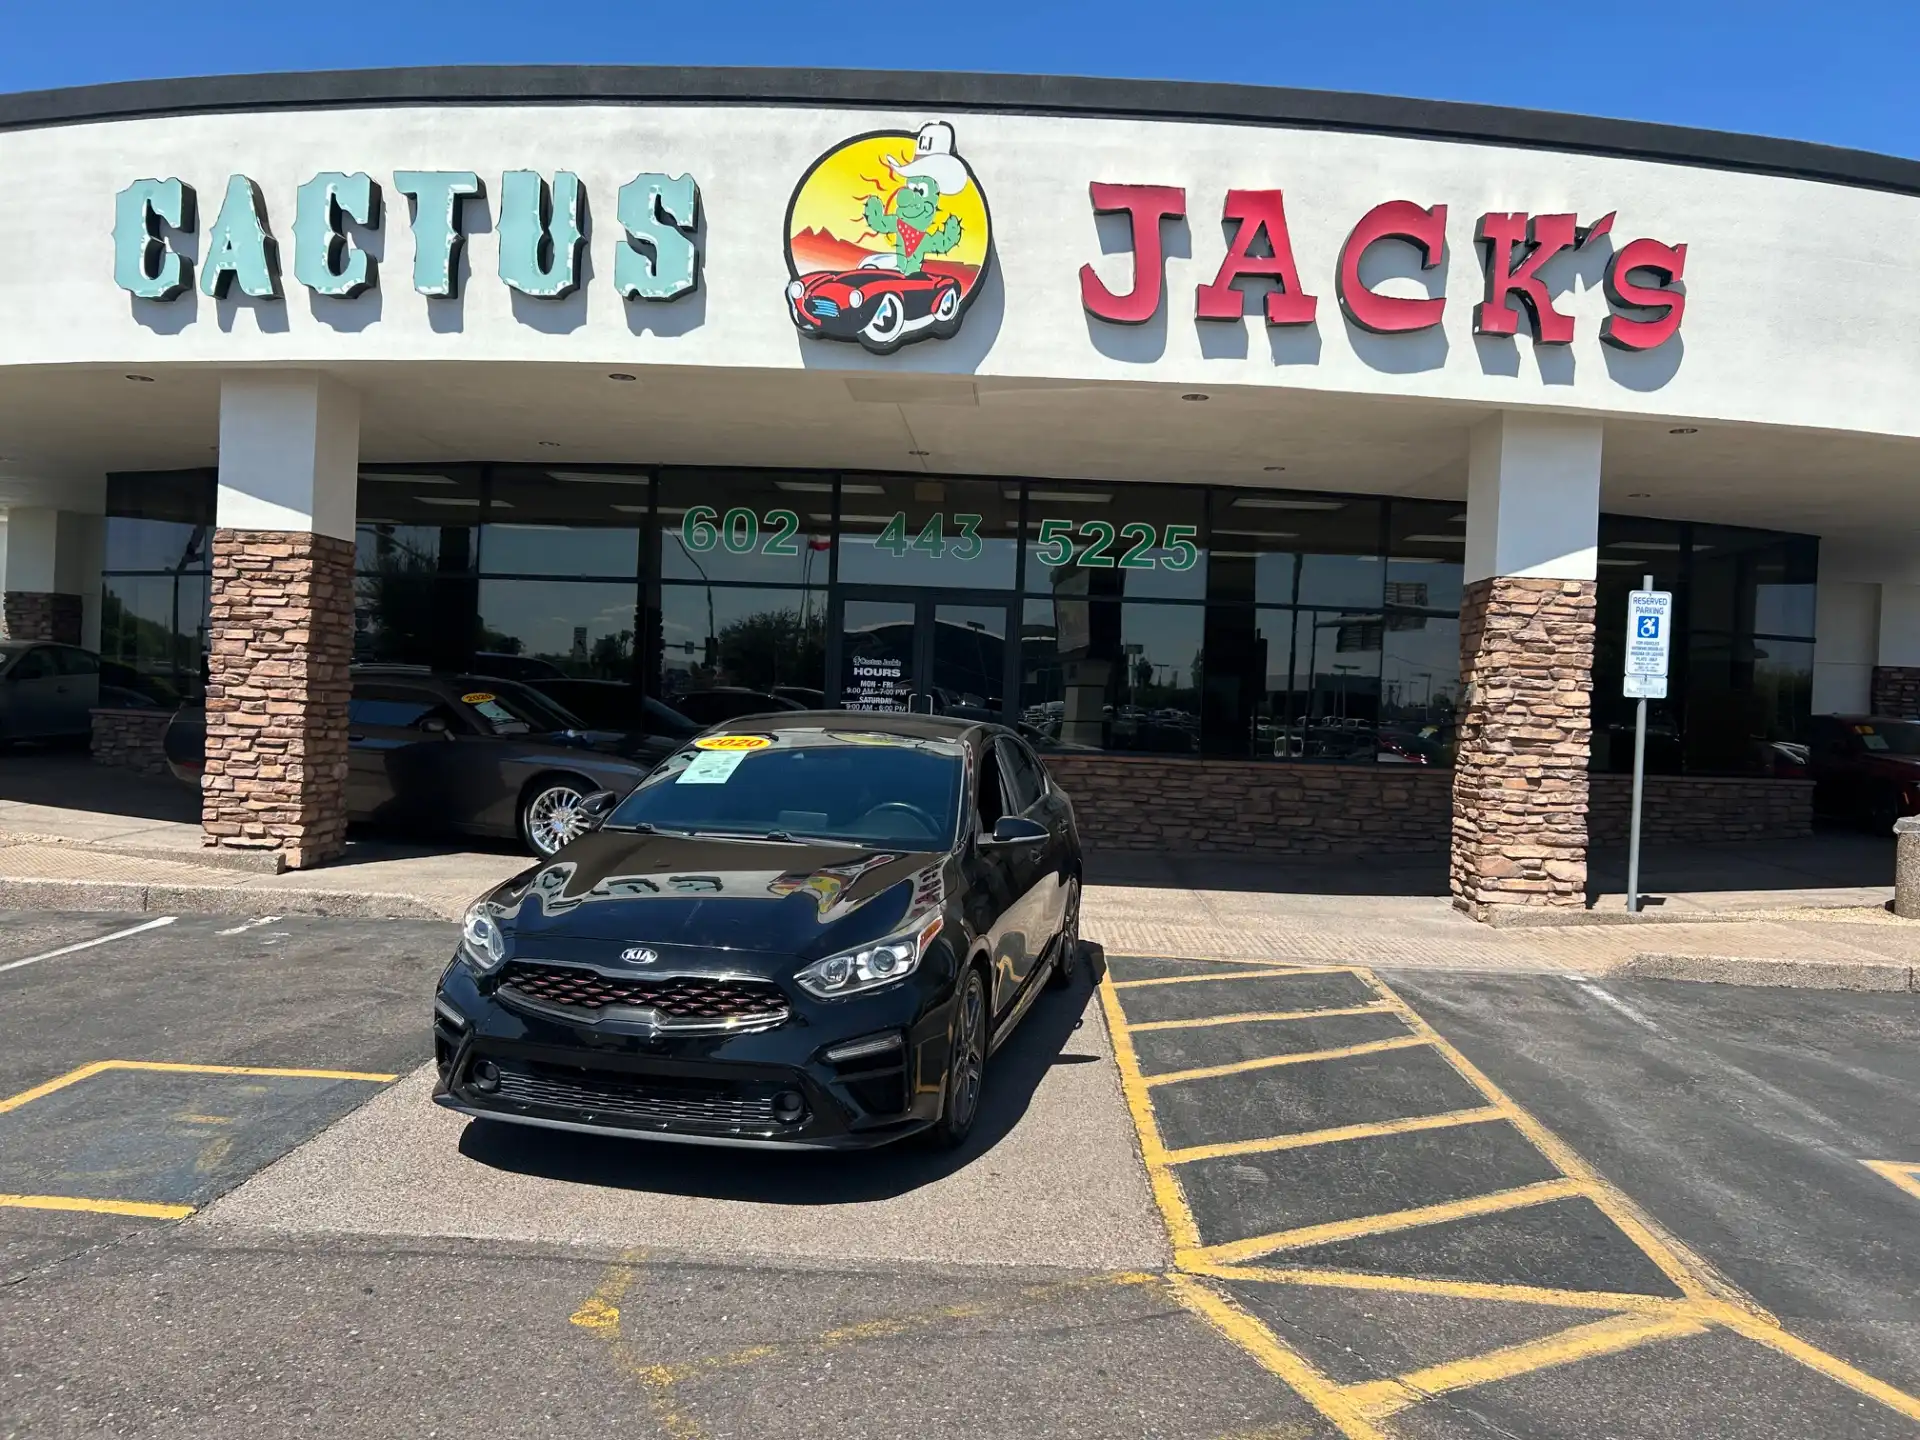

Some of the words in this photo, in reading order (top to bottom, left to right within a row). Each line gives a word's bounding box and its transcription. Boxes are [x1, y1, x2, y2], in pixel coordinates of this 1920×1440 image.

[919, 136, 933, 151] CJ
[112, 168, 701, 301] CACTUS
[682, 505, 800, 556] 602
[873, 511, 983, 560] 443
[1036, 519, 1198, 571] 5225
[1633, 596, 1668, 606] RESERVED
[1636, 606, 1664, 615] PARKING
[854, 667, 901, 678] HOURS
[704, 739, 764, 747] 2020
[625, 949, 652, 961] KIA
